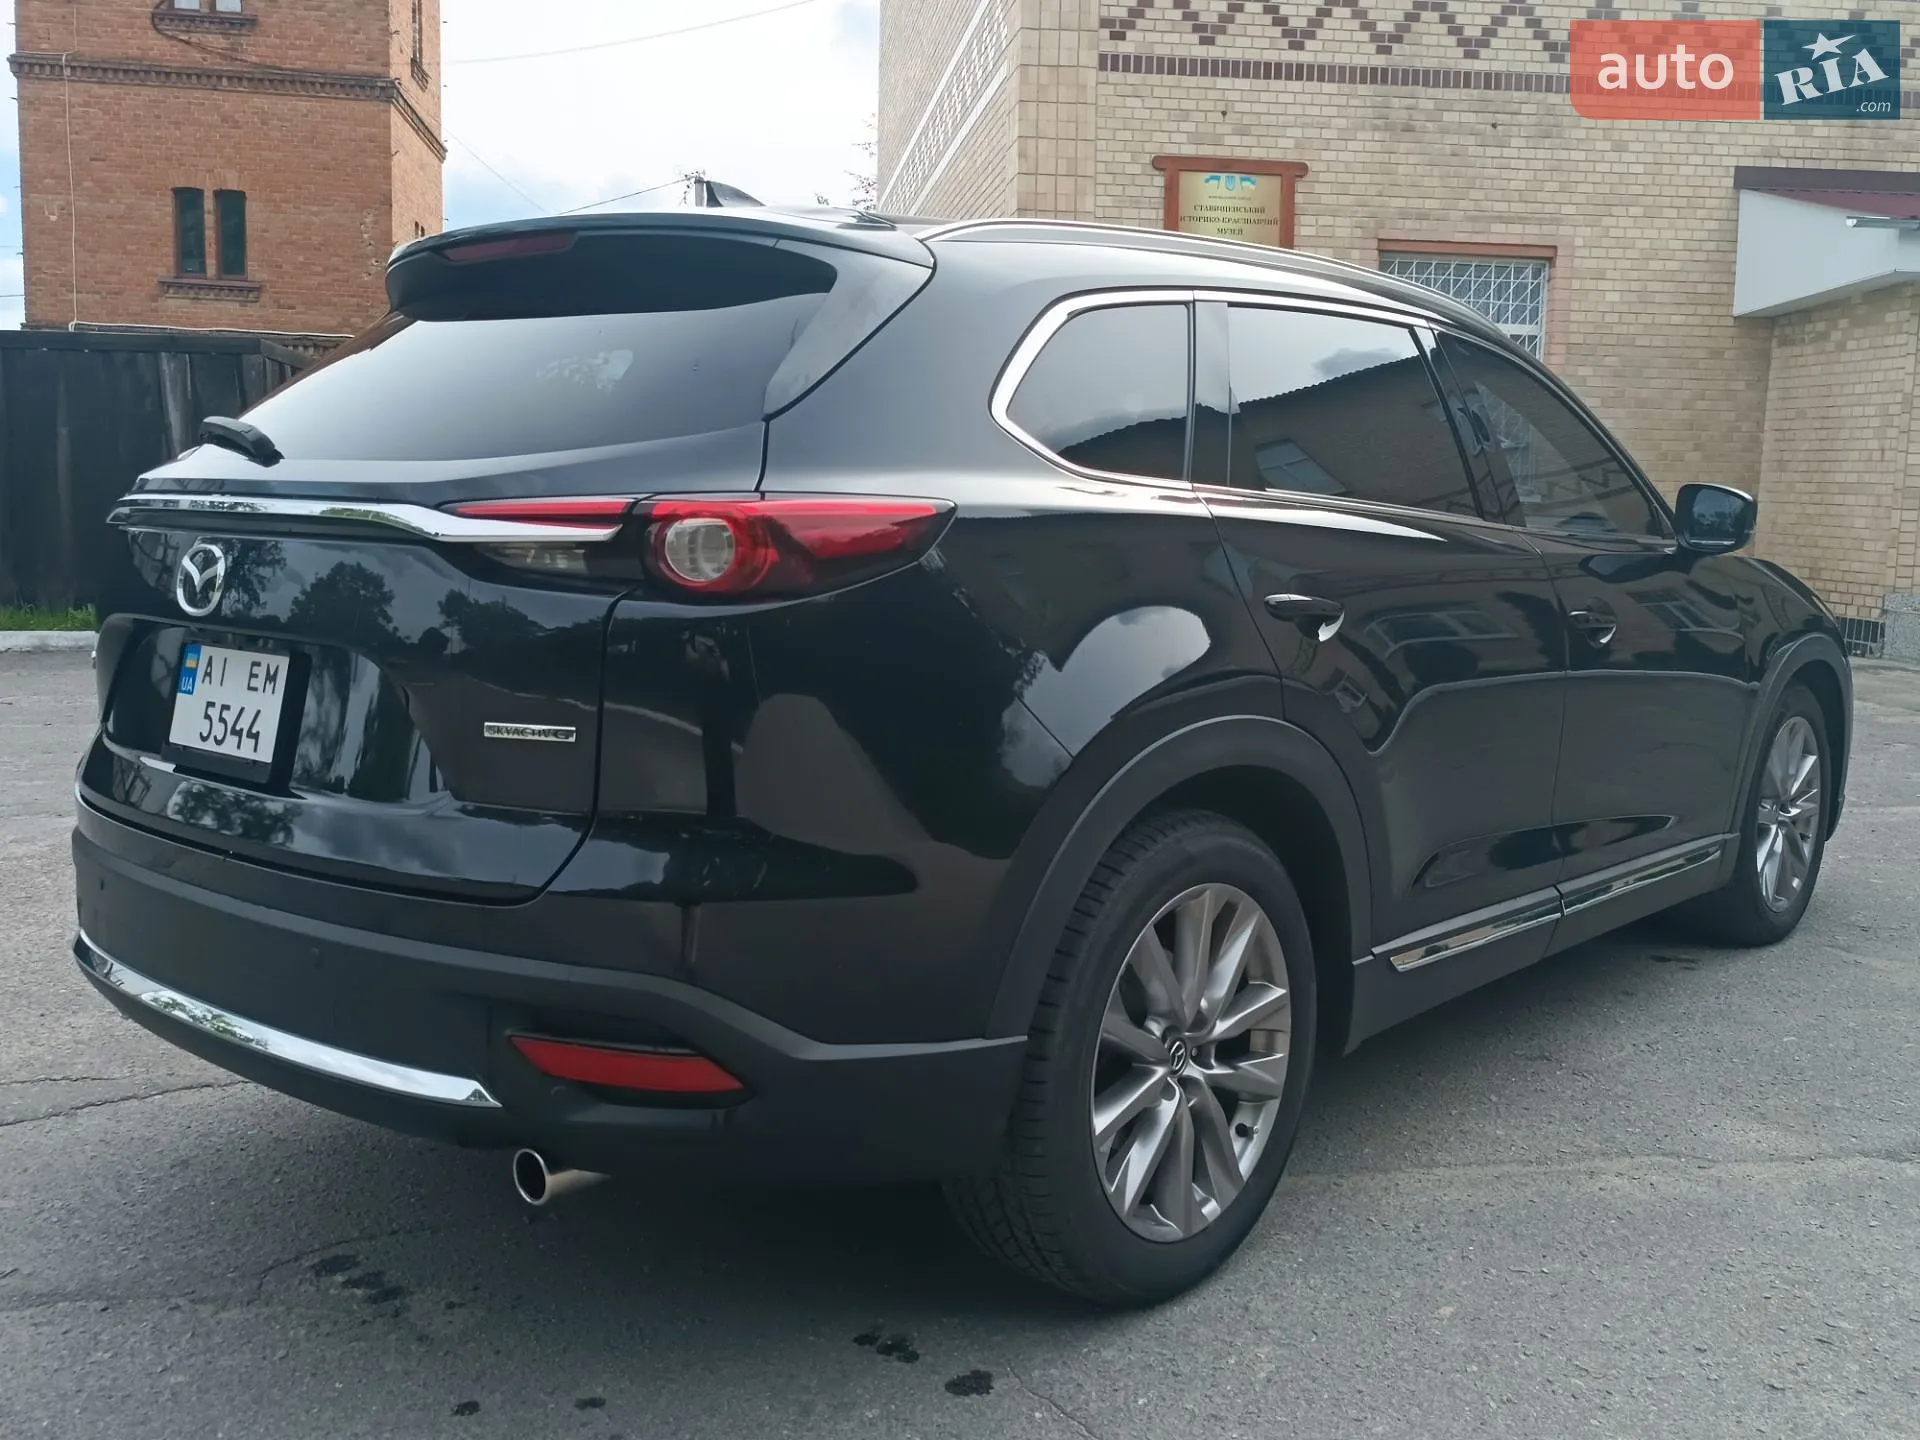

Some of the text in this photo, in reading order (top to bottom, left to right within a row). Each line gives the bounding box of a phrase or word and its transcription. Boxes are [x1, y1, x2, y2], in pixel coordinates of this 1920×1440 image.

[1216, 227, 1243, 236] МУЗЕЙ
[181, 676, 194, 692] UA
[247, 660, 280, 695] EM
[199, 700, 262, 754] 5544
